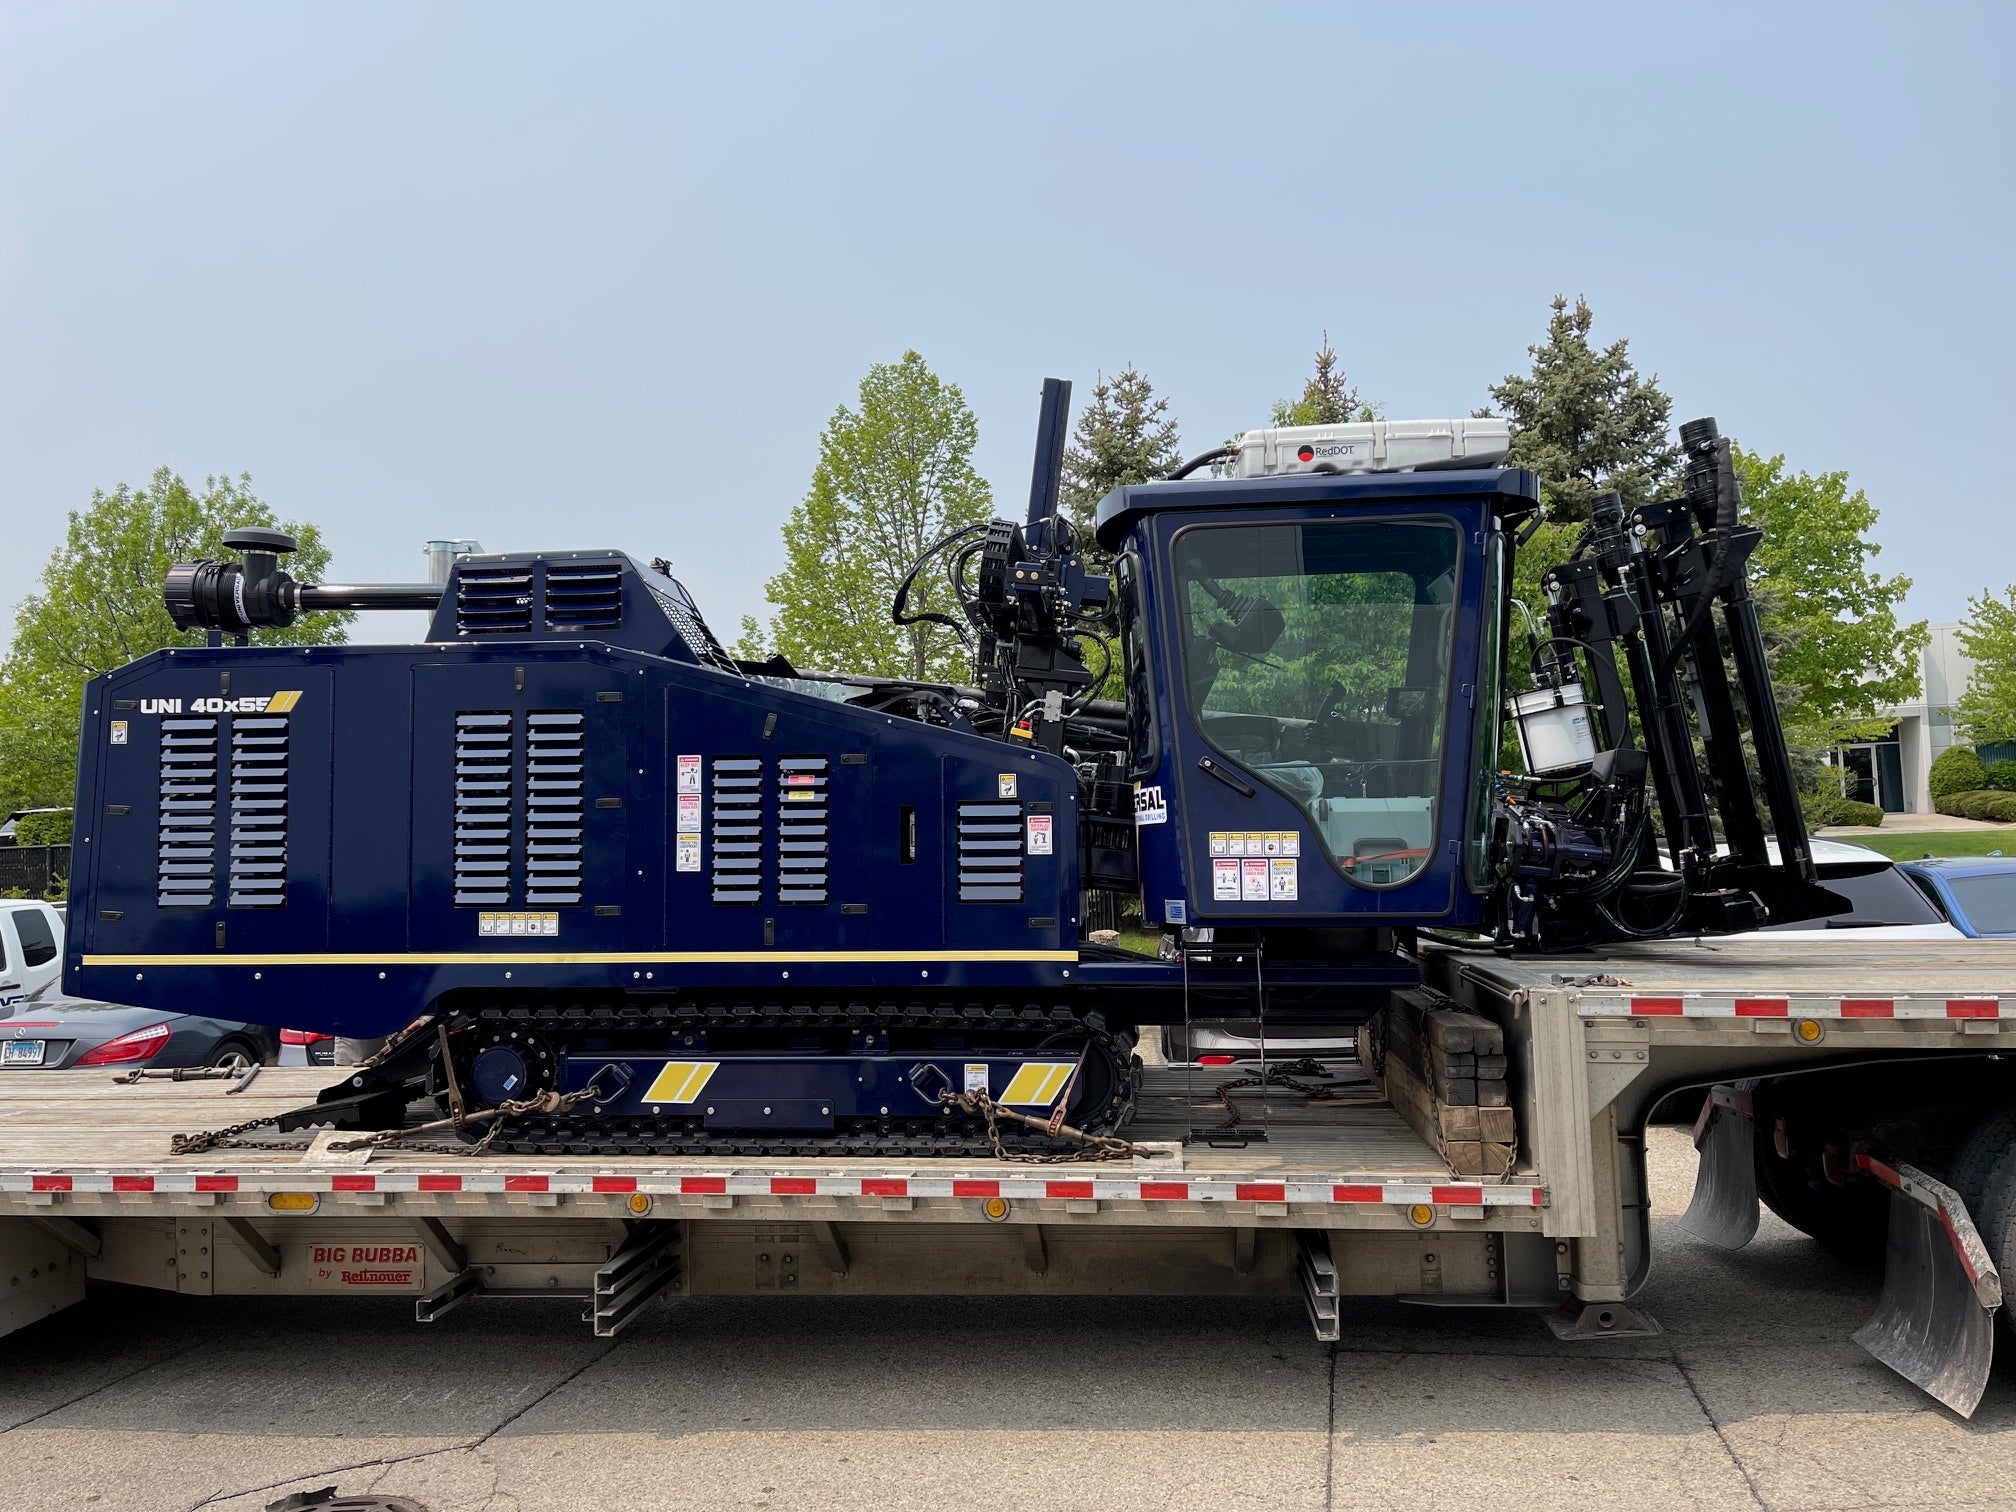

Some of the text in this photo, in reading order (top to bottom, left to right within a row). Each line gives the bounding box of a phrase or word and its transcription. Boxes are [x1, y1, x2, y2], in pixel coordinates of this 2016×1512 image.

[1315, 445, 1355, 456] RedDOT
[140, 698, 182, 714] UNI
[313, 1247, 418, 1263] BIG BUBBA
[319, 1267, 412, 1284] by Reitnouer
